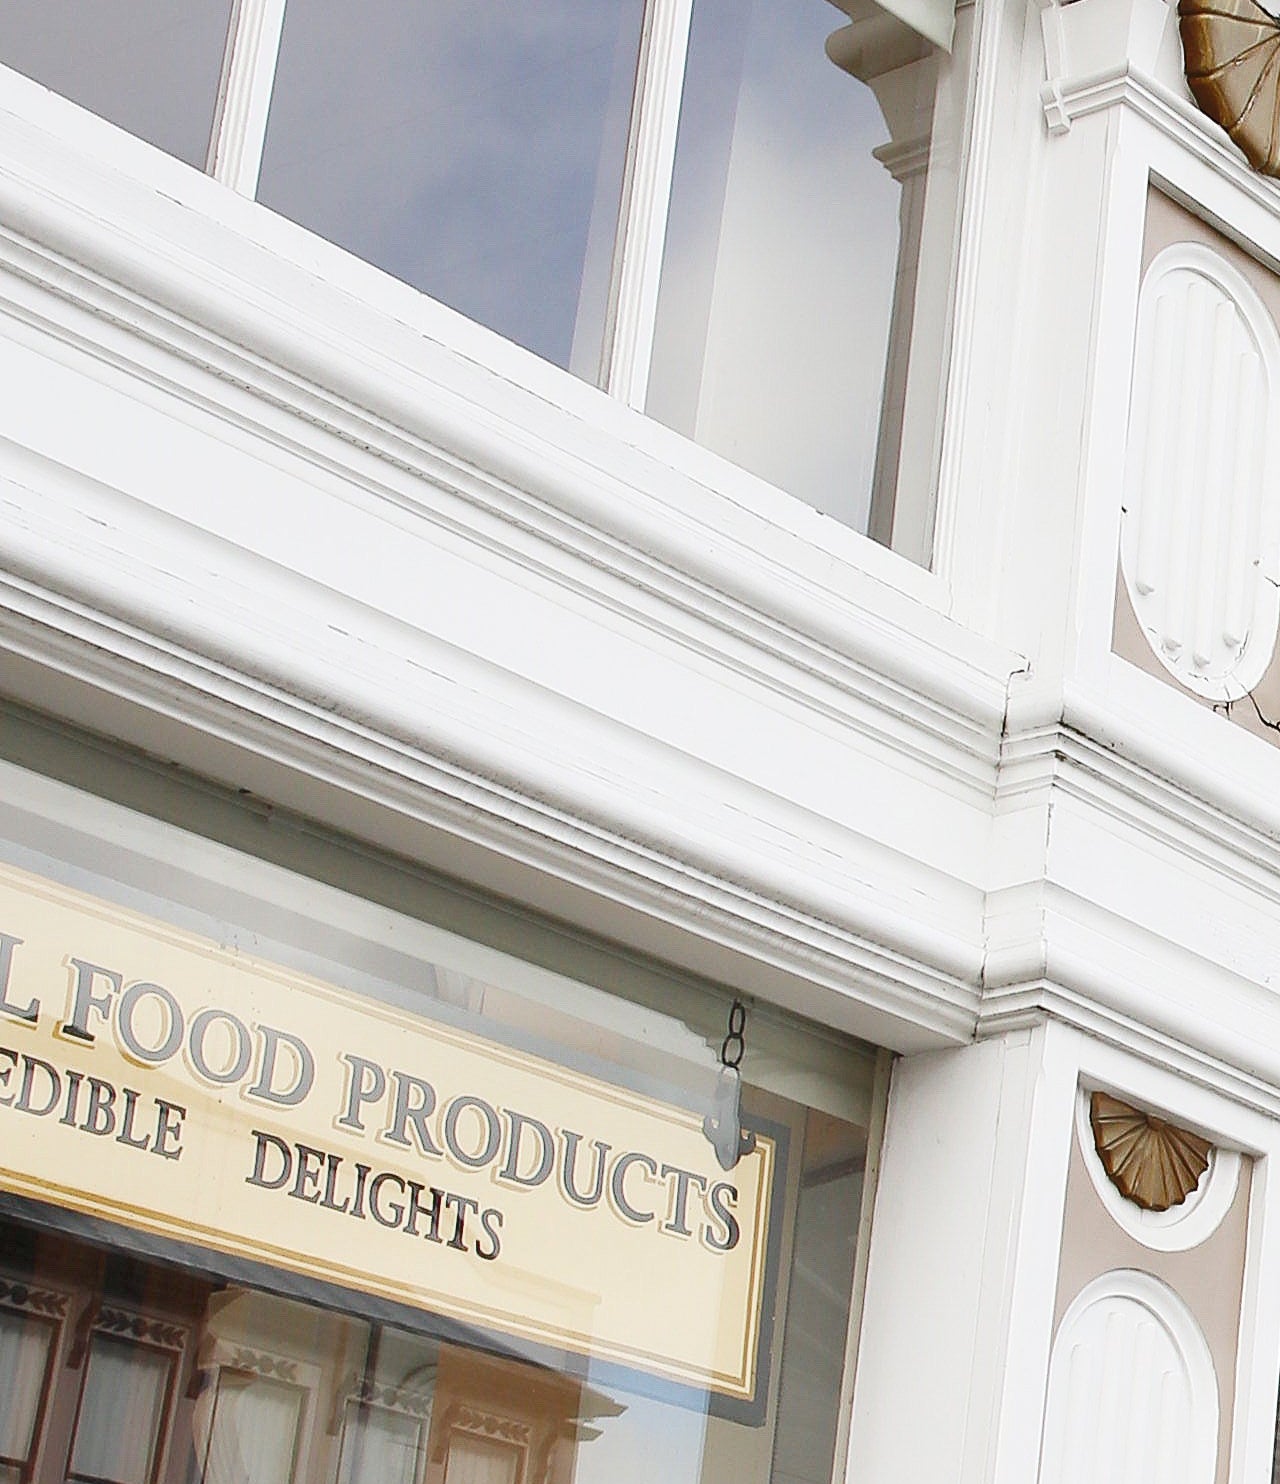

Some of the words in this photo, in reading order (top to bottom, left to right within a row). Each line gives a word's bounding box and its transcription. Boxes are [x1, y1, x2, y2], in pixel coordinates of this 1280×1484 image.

[62, 955, 317, 1109] FOOD
[337, 1049, 742, 1255] PRODUCTS
[246, 1128, 506, 1262] DELIGHTS
